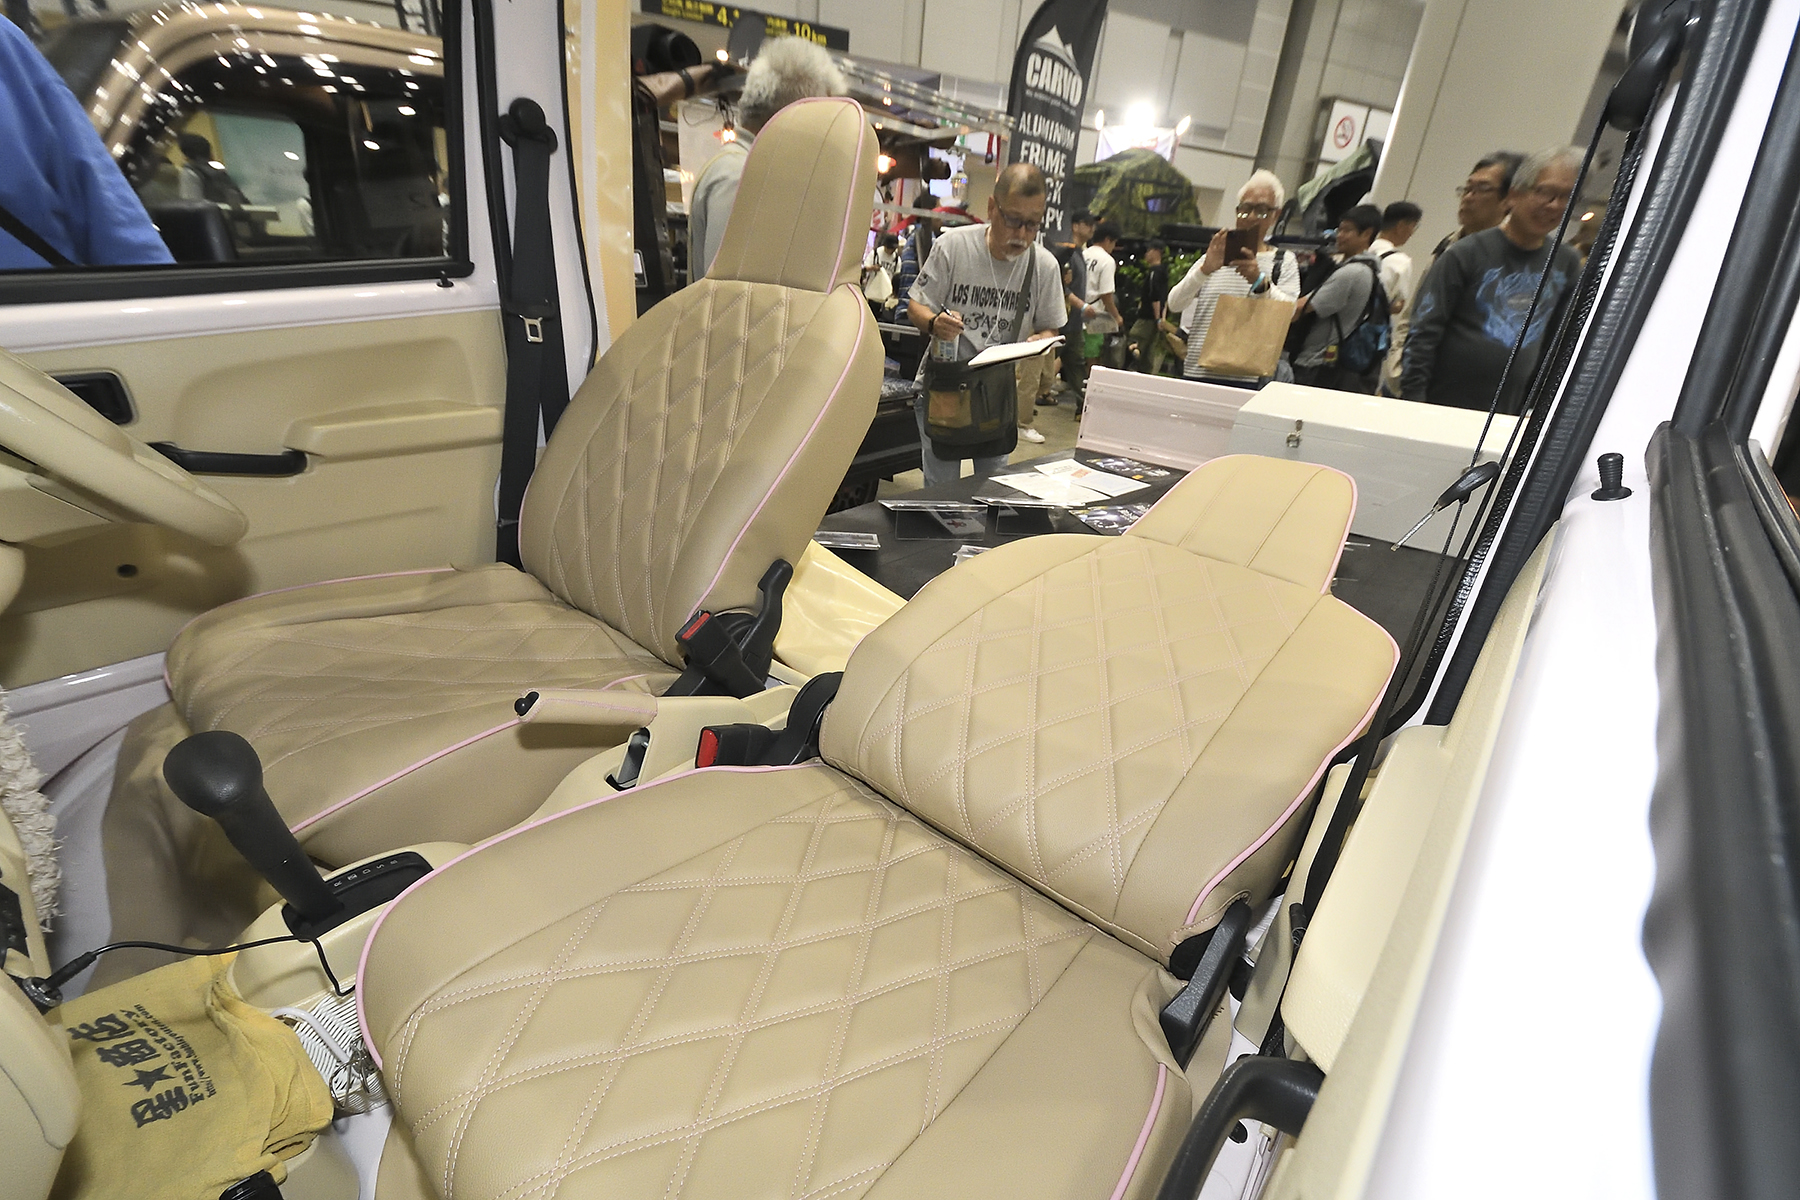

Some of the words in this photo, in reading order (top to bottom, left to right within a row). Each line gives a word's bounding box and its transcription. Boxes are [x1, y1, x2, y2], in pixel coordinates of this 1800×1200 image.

[1025, 52, 1083, 108] CARVO
[1018, 111, 1076, 151] ALUMINUM
[1019, 139, 1068, 178] FRAME
[951, 283, 970, 305] LOS
